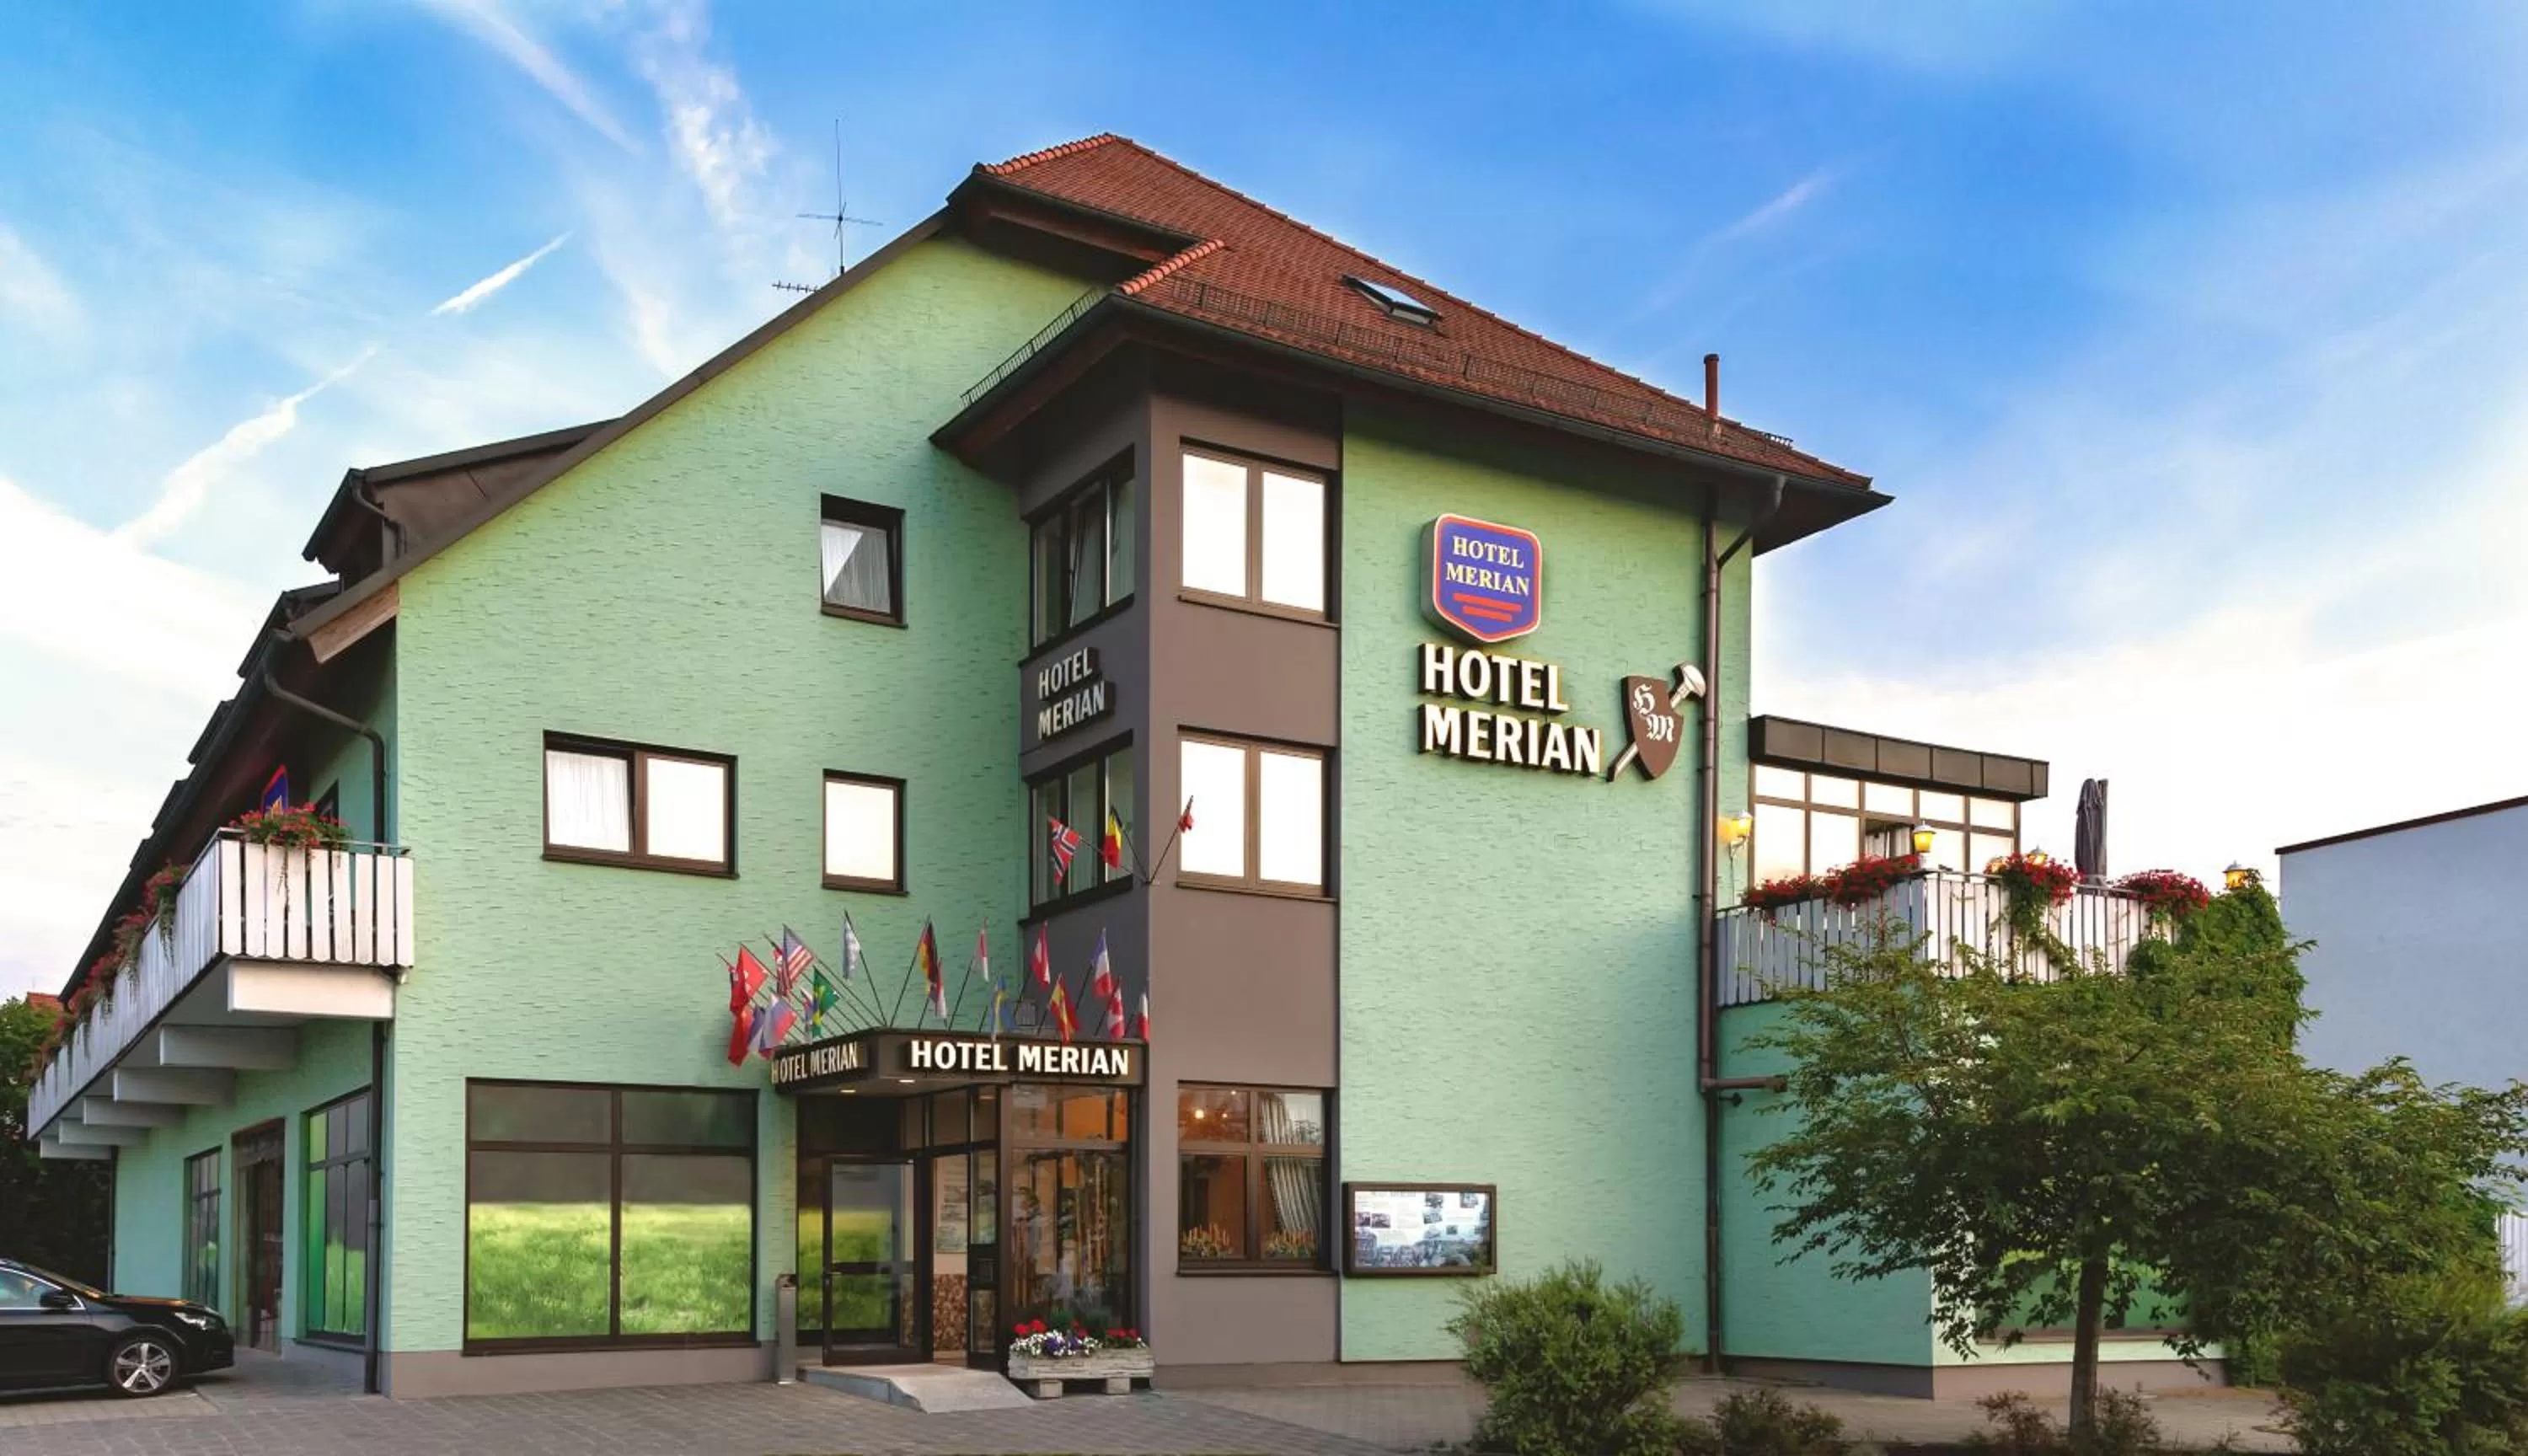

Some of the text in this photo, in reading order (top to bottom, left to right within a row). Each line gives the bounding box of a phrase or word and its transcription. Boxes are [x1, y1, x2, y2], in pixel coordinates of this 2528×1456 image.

[1453, 535, 1524, 570] HOTEL
[1445, 562, 1529, 597] MERIAN
[1037, 646, 1093, 700] HOTEL
[1422, 643, 1570, 712] HOTEL
[1037, 680, 1106, 741] MERIAN
[1422, 704, 1600, 774] MERIAN
[771, 1041, 859, 1085] HOTEL MERIAN
[910, 1040, 1129, 1076] HOTEL MERIAN
